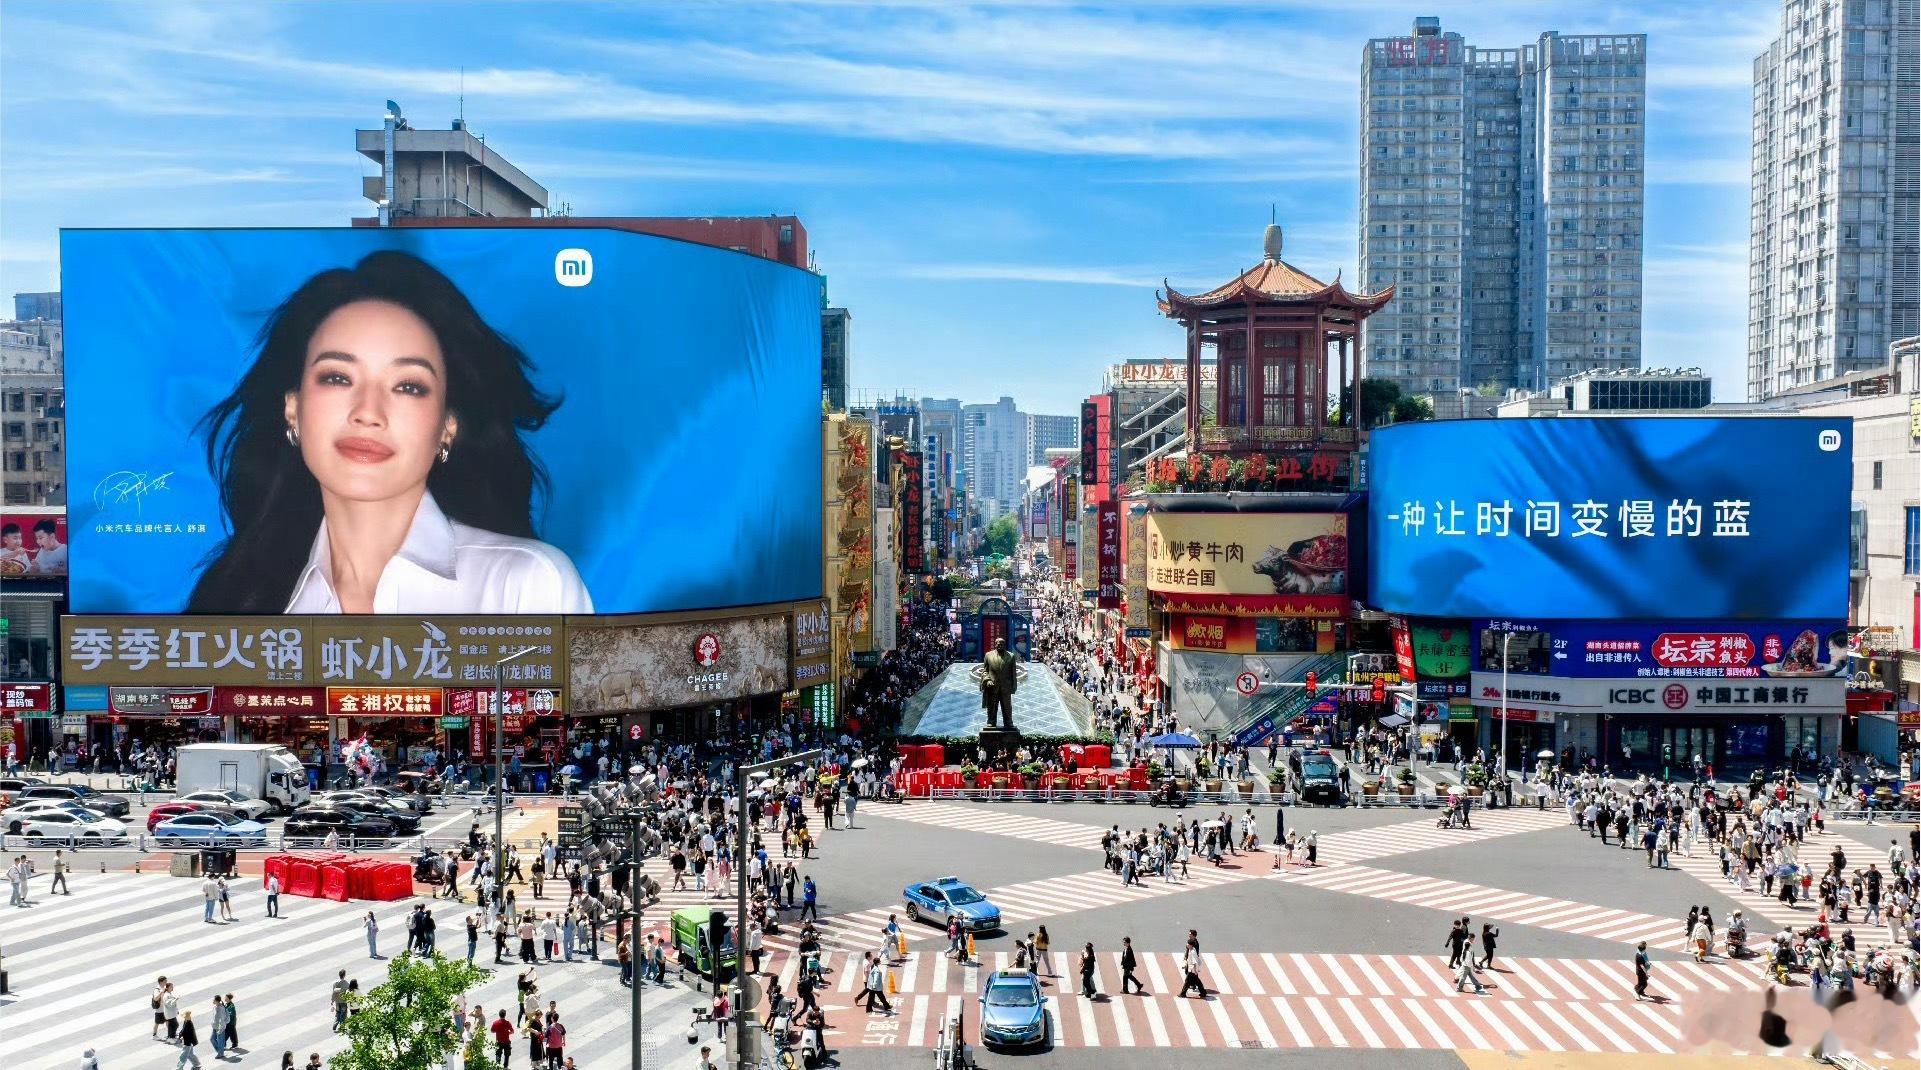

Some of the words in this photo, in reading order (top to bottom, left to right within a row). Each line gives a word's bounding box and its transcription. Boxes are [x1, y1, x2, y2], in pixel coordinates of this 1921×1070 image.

[1122, 361, 1175, 380] 虾小龙
[1387, 499, 1751, 538] 一种让时间变慢的蓝
[95, 524, 183, 533] 小米汽车品牌代言人
[187, 524, 207, 533] 舒淇
[1160, 540, 1244, 563] 小炒黄牛肉
[797, 611, 829, 635] 虾小龙
[1489, 620, 1512, 631] 坛宗
[1187, 622, 1224, 640] 炊烟
[71, 628, 303, 670] 季季红火锅
[1554, 639, 1568, 649] 2F
[1586, 641, 1640, 650] 湖南头道招牌菜
[1719, 637, 1747, 649] 剁椒
[459, 645, 488, 655] 国金店
[1660, 637, 1716, 664] 坛宗
[321, 634, 453, 680] 虾小龙
[1586, 653, 1642, 663] 出自非遗传人
[1435, 662, 1453, 674] 3F
[1725, 667, 1760, 677] 第四代传人
[267, 672, 303, 681] 请上二楼
[687, 672, 728, 684] CHAGEE
[115, 694, 160, 704] 湖南特产
[1482, 687, 1501, 698] 24h
[1507, 688, 1561, 702] 自助银行服务
[1609, 689, 1655, 703] ICBC
[1697, 687, 1809, 704] 中国工商银行
[6, 698, 34, 708] 盖码饭
[247, 695, 314, 707] 墨茉点心局
[339, 695, 404, 711] 金湘权
